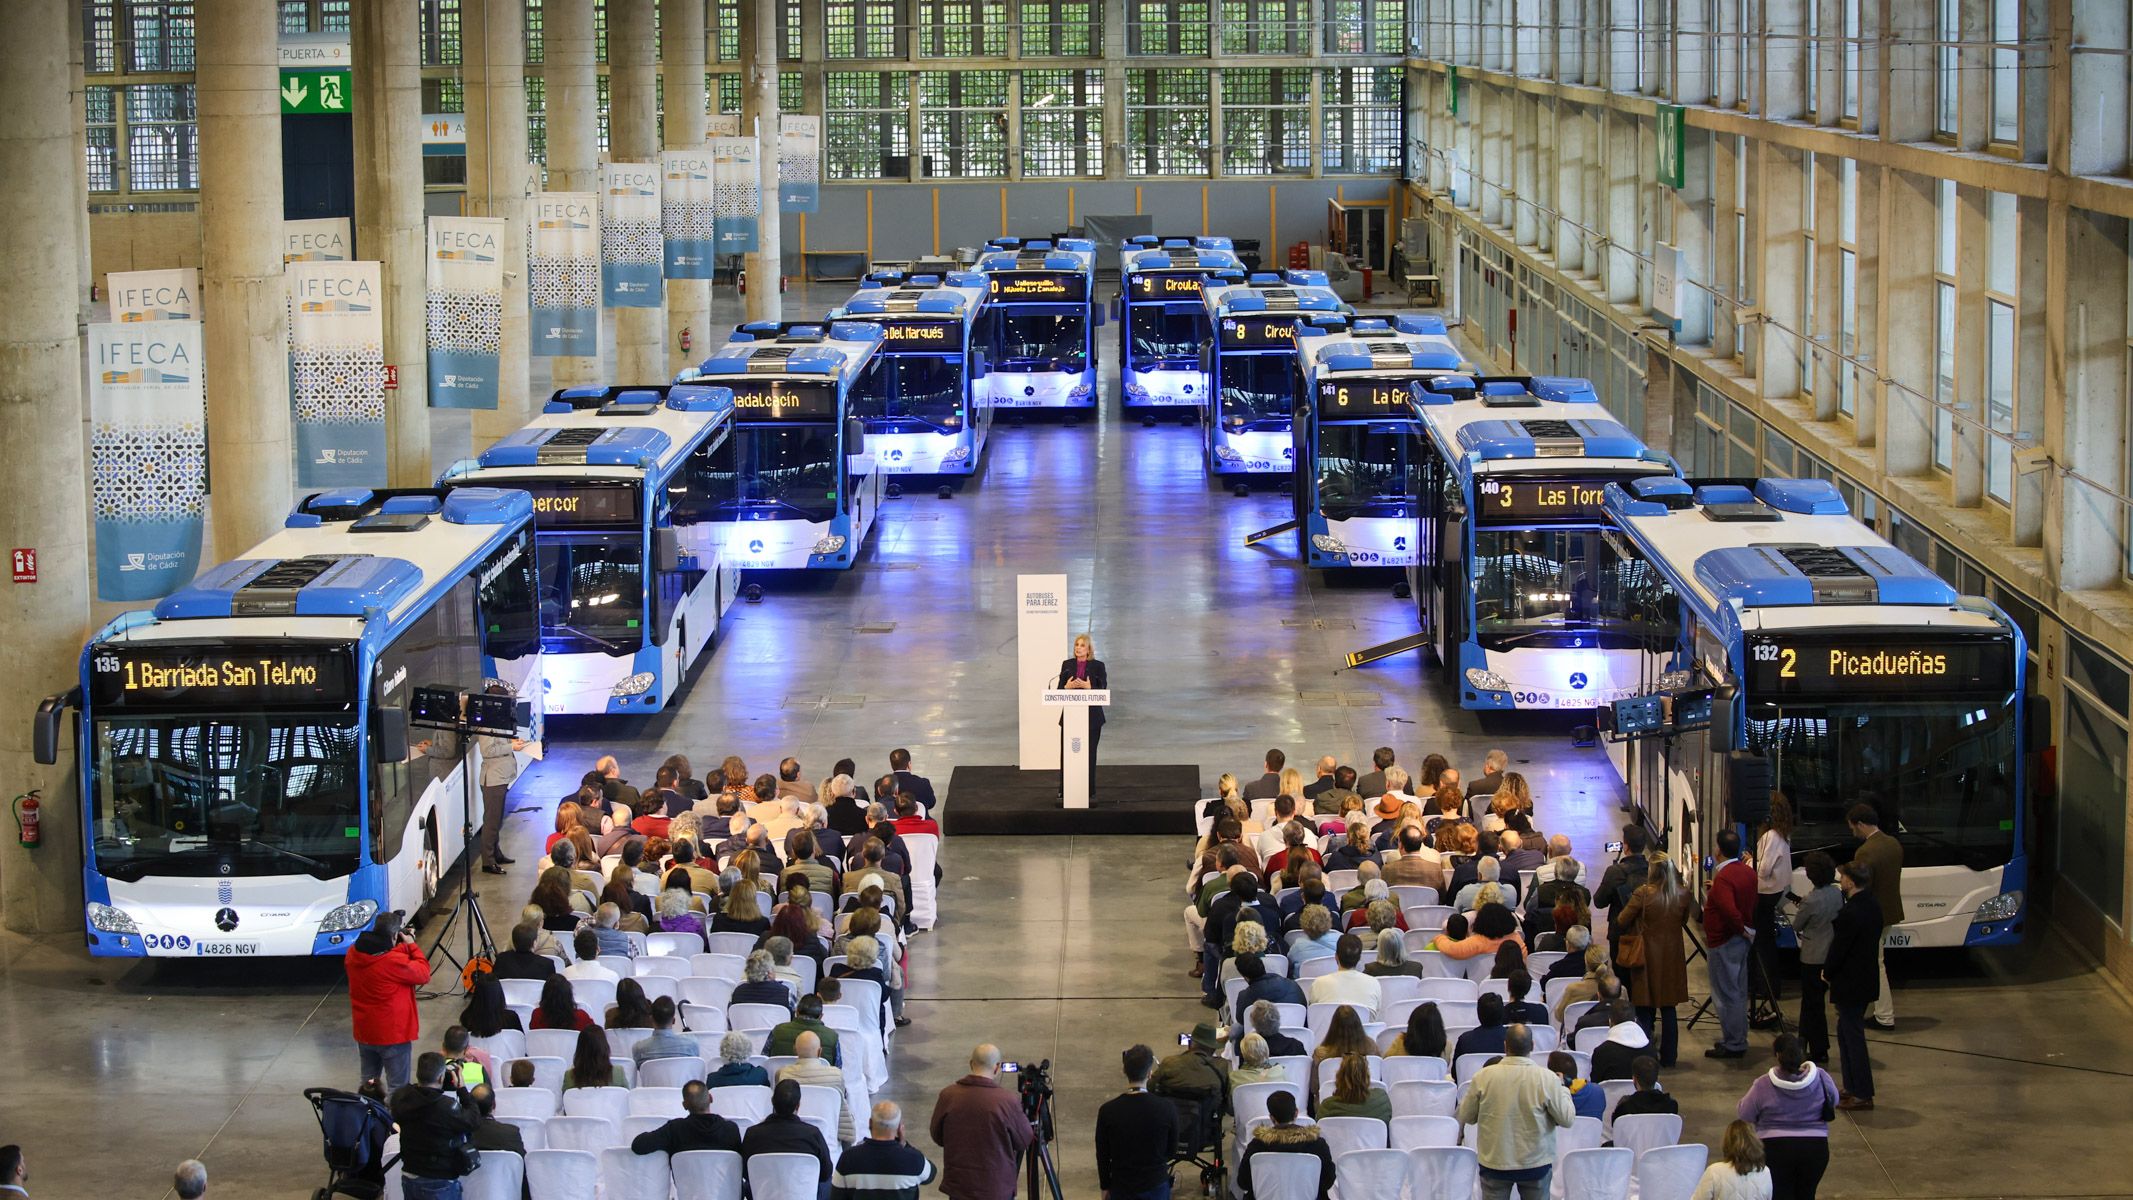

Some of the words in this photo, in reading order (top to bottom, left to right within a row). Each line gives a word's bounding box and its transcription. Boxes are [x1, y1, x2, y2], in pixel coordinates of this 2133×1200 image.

[283, 48, 325, 60] PUERTA
[333, 48, 341, 58] 9
[707, 122, 736, 131] FECA
[784, 122, 816, 131] IFECA
[666, 160, 708, 171] IFECA
[608, 173, 655, 186] IFECA
[537, 204, 590, 218] IFECA
[289, 233, 344, 250] FECA
[435, 231, 496, 249] IFECA
[300, 279, 371, 296] IFECA
[1144, 278, 1151, 292] 9
[118, 287, 190, 308] IFECA
[889, 327, 904, 340] Del
[906, 326, 944, 340] Marqués
[1236, 324, 1245, 339] 8
[101, 343, 189, 364] IFECA
[1321, 385, 1336, 395] 141
[1338, 388, 1348, 406] 6
[1373, 388, 1388, 404] La
[338, 449, 368, 457] Diputación
[347, 456, 363, 464] Cádiz
[1479, 482, 1499, 494] 140
[1500, 485, 1513, 507] 3
[1538, 486, 1566, 506] Las
[147, 551, 185, 562] Diputación
[148, 562, 157, 570] de
[160, 560, 178, 570] Cádiz
[1753, 645, 1778, 660] 132
[94, 657, 120, 672] 135
[1780, 648, 1796, 677] 2
[1830, 649, 1946, 675] Picadueñas
[124, 661, 138, 690] 1
[141, 661, 218, 689] Barriada
[222, 661, 256, 686] San
[260, 660, 316, 686] Telmo
[1889, 936, 1911, 946] NGV
[204, 944, 232, 954] 4826
[235, 944, 257, 954] NGV
